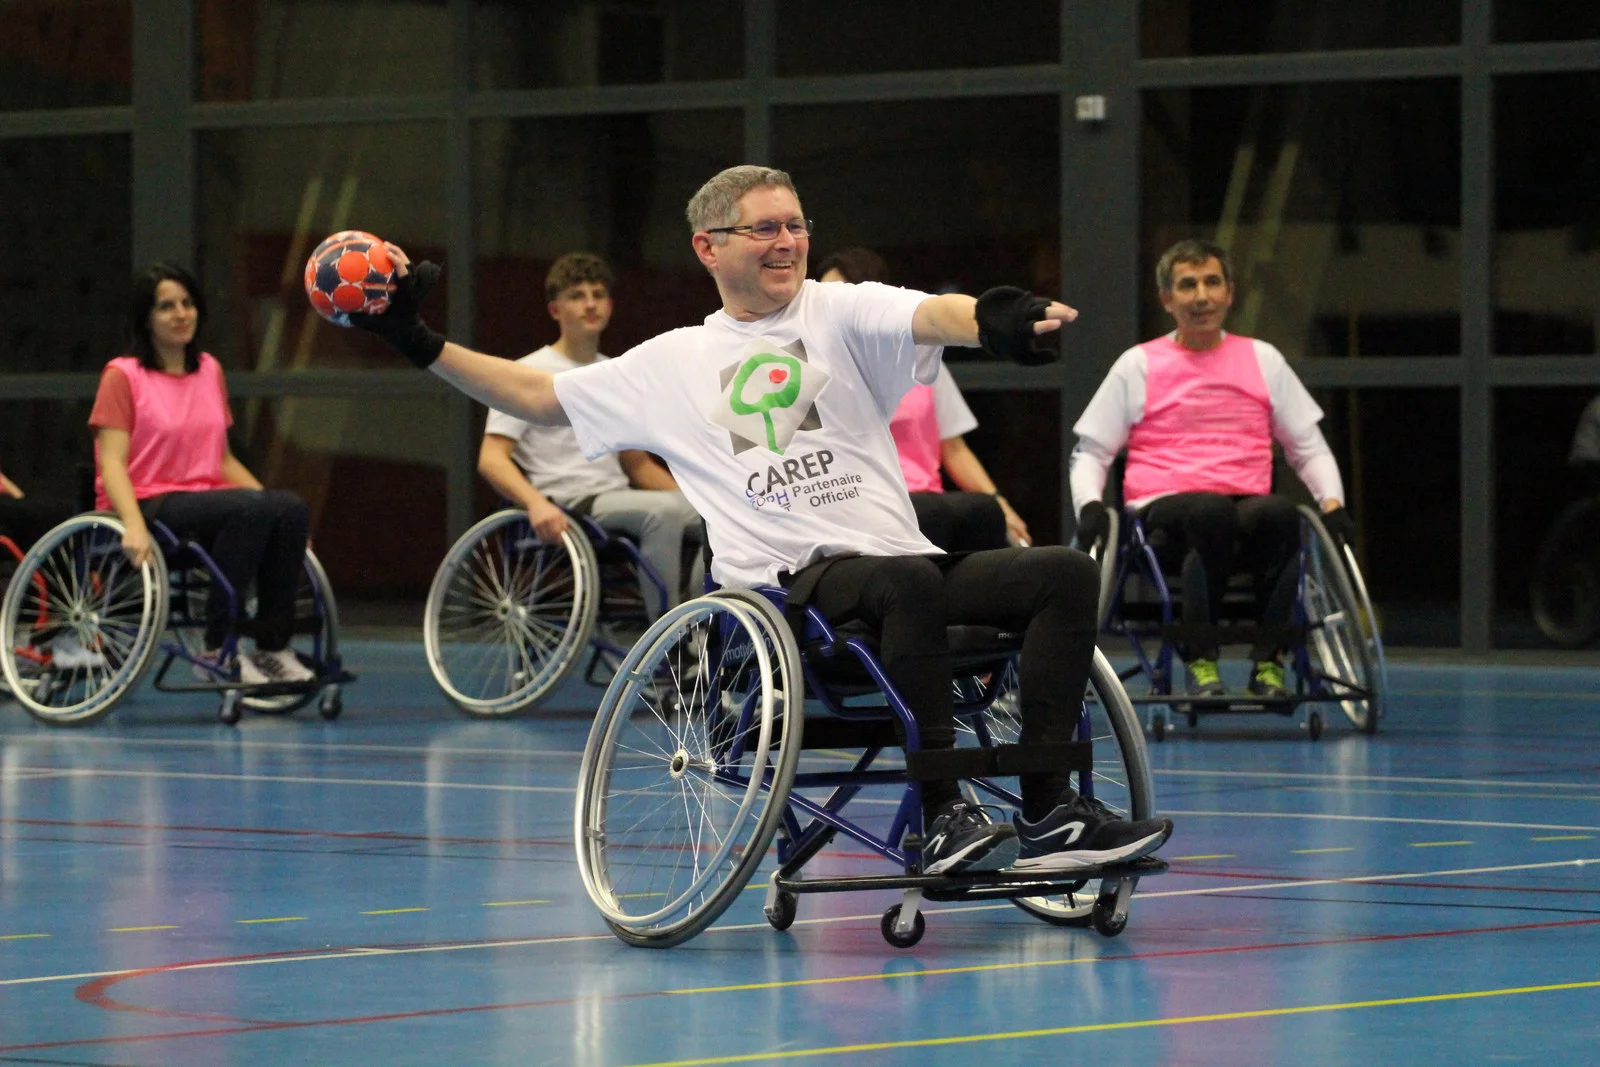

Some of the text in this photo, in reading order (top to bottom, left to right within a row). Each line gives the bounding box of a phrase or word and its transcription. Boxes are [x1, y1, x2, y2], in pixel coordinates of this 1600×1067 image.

[748, 450, 834, 496] CAREP
[792, 474, 862, 498] Partenaire
[809, 486, 860, 507] Officiel
